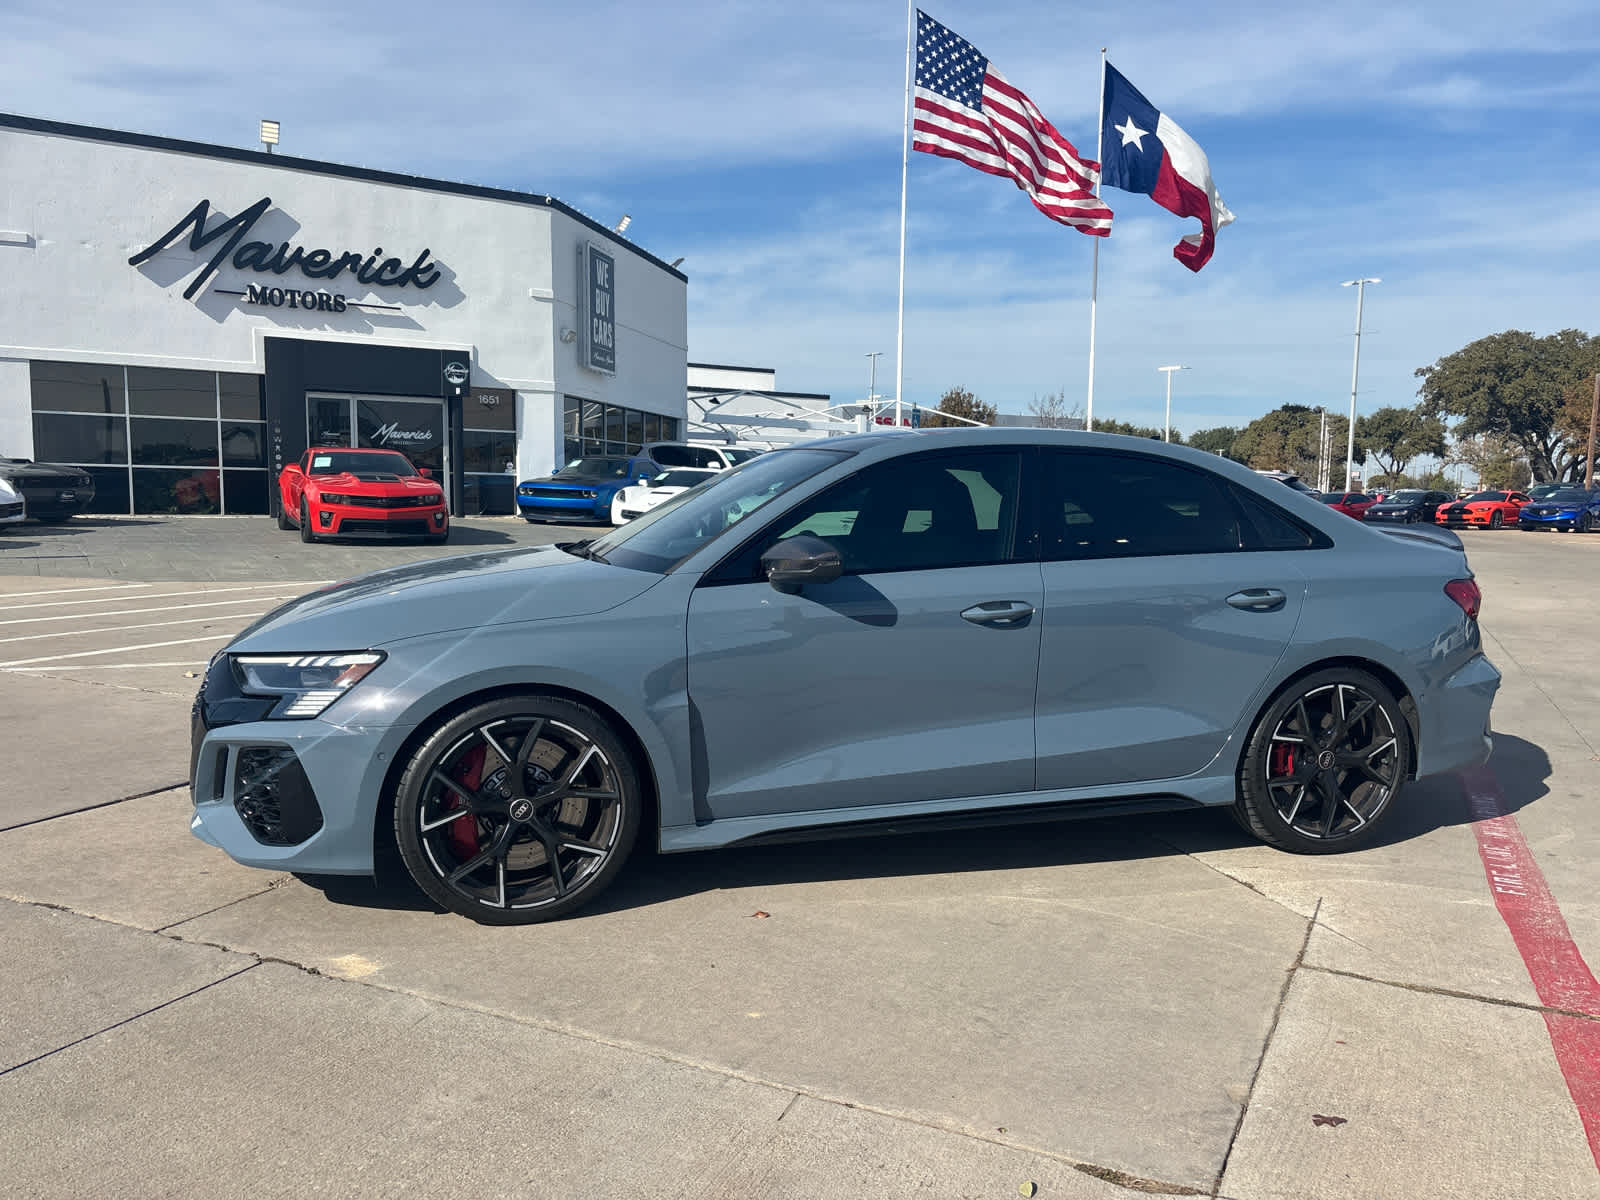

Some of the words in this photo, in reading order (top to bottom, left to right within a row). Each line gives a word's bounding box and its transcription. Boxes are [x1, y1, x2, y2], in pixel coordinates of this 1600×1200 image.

[128, 197, 441, 299] Maverick
[596, 259, 609, 289] WE
[247, 285, 347, 313] MOTORS
[595, 288, 610, 318] BUY
[593, 317, 613, 349] CARS
[478, 394, 500, 405] 1651
[370, 422, 433, 445] Maverick
